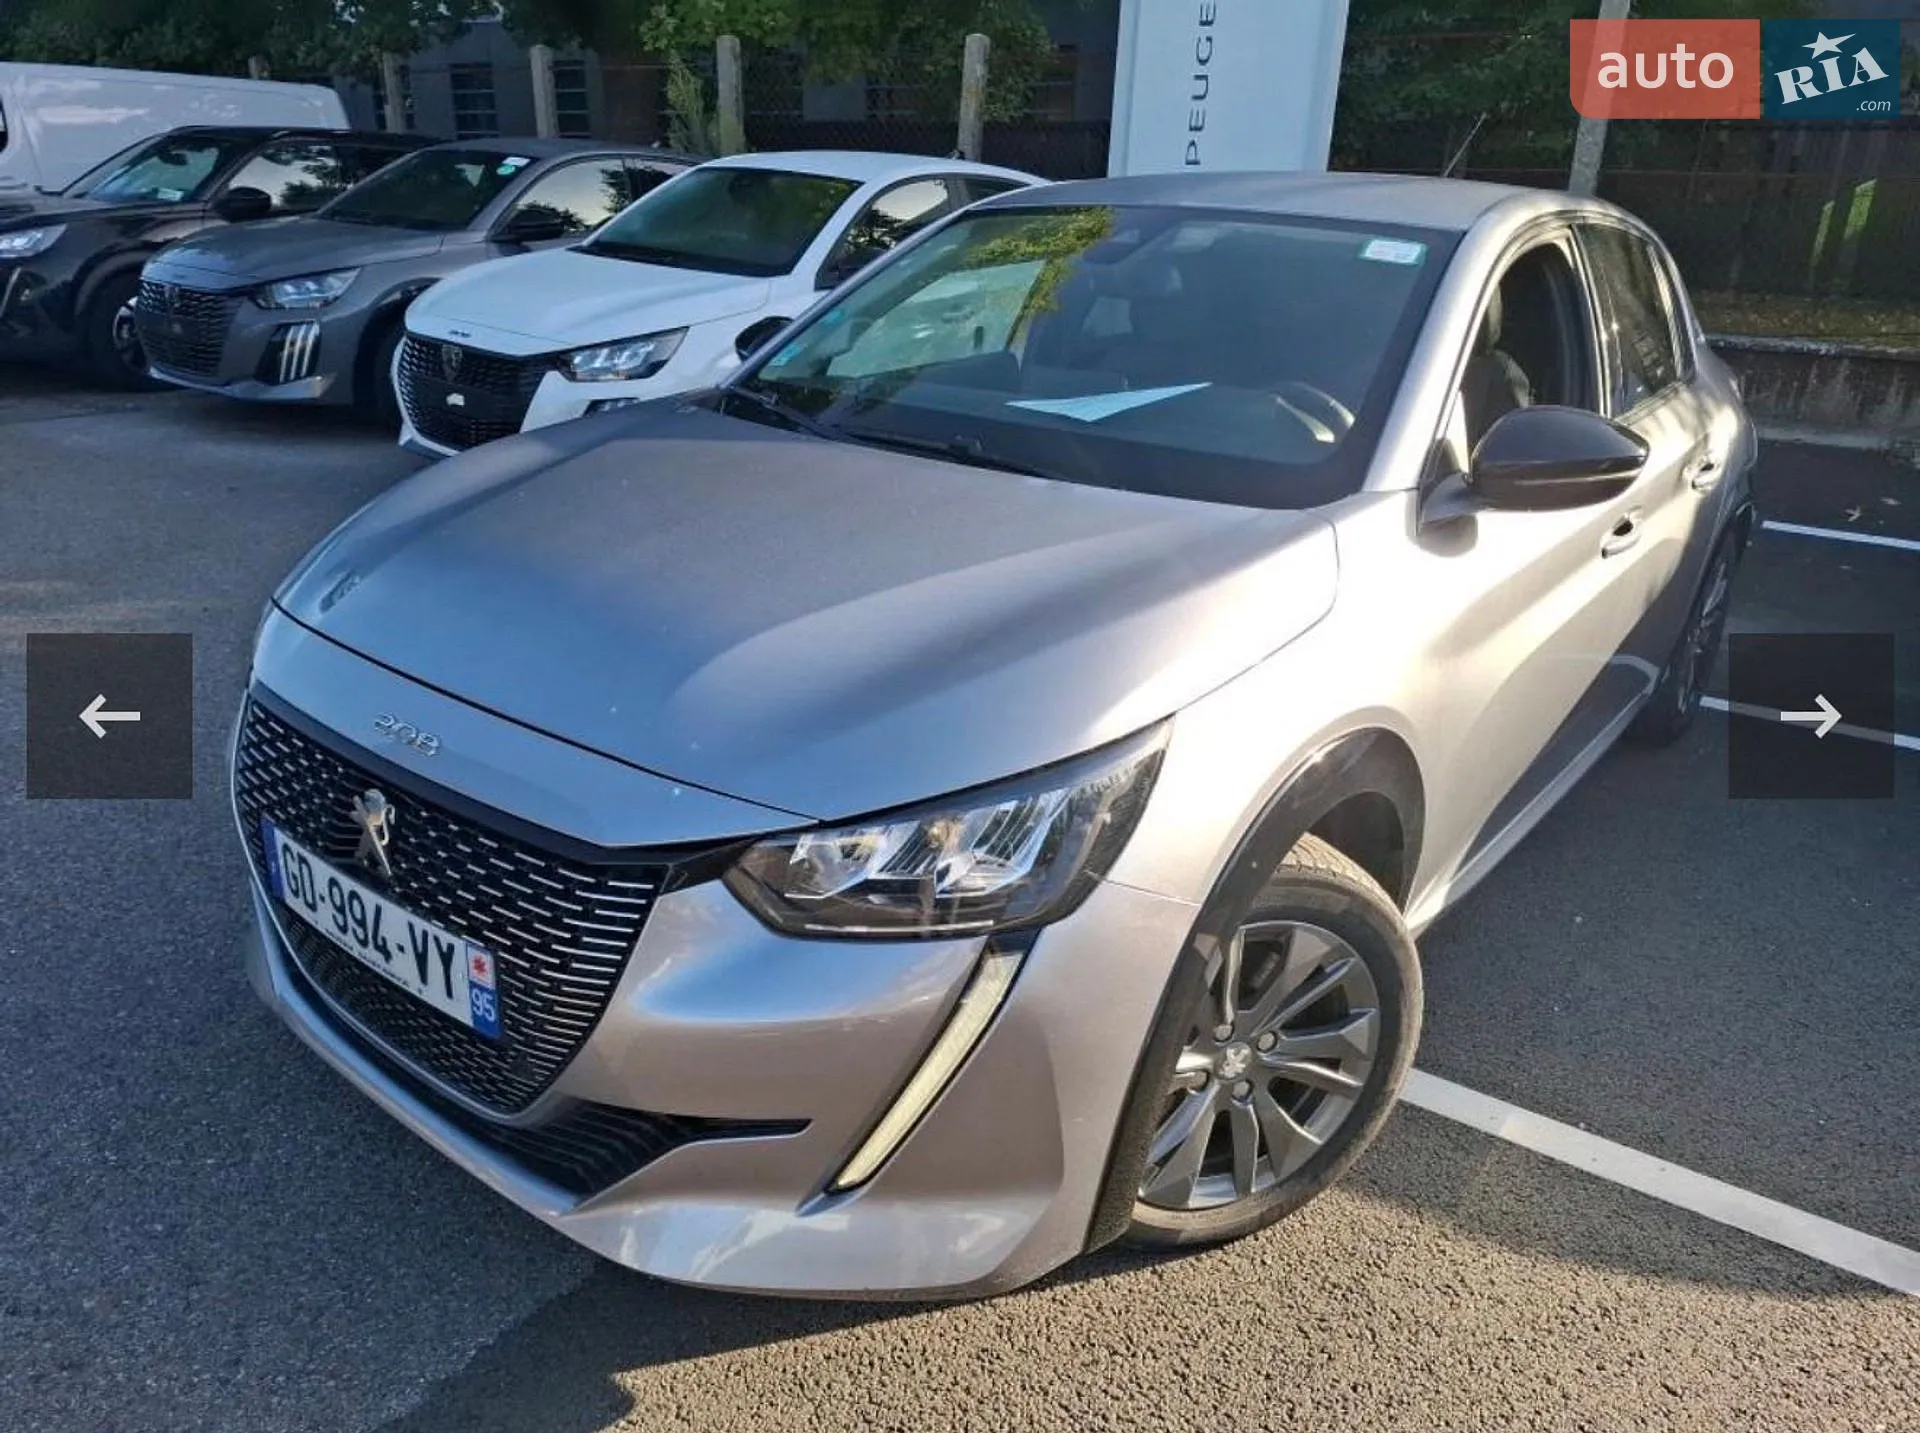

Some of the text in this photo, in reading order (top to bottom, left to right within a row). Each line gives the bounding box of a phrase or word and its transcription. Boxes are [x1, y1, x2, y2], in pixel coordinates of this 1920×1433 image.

[373, 711, 440, 757] 208
[282, 842, 455, 1000] GD-994-VY
[472, 988, 497, 1023] 95
